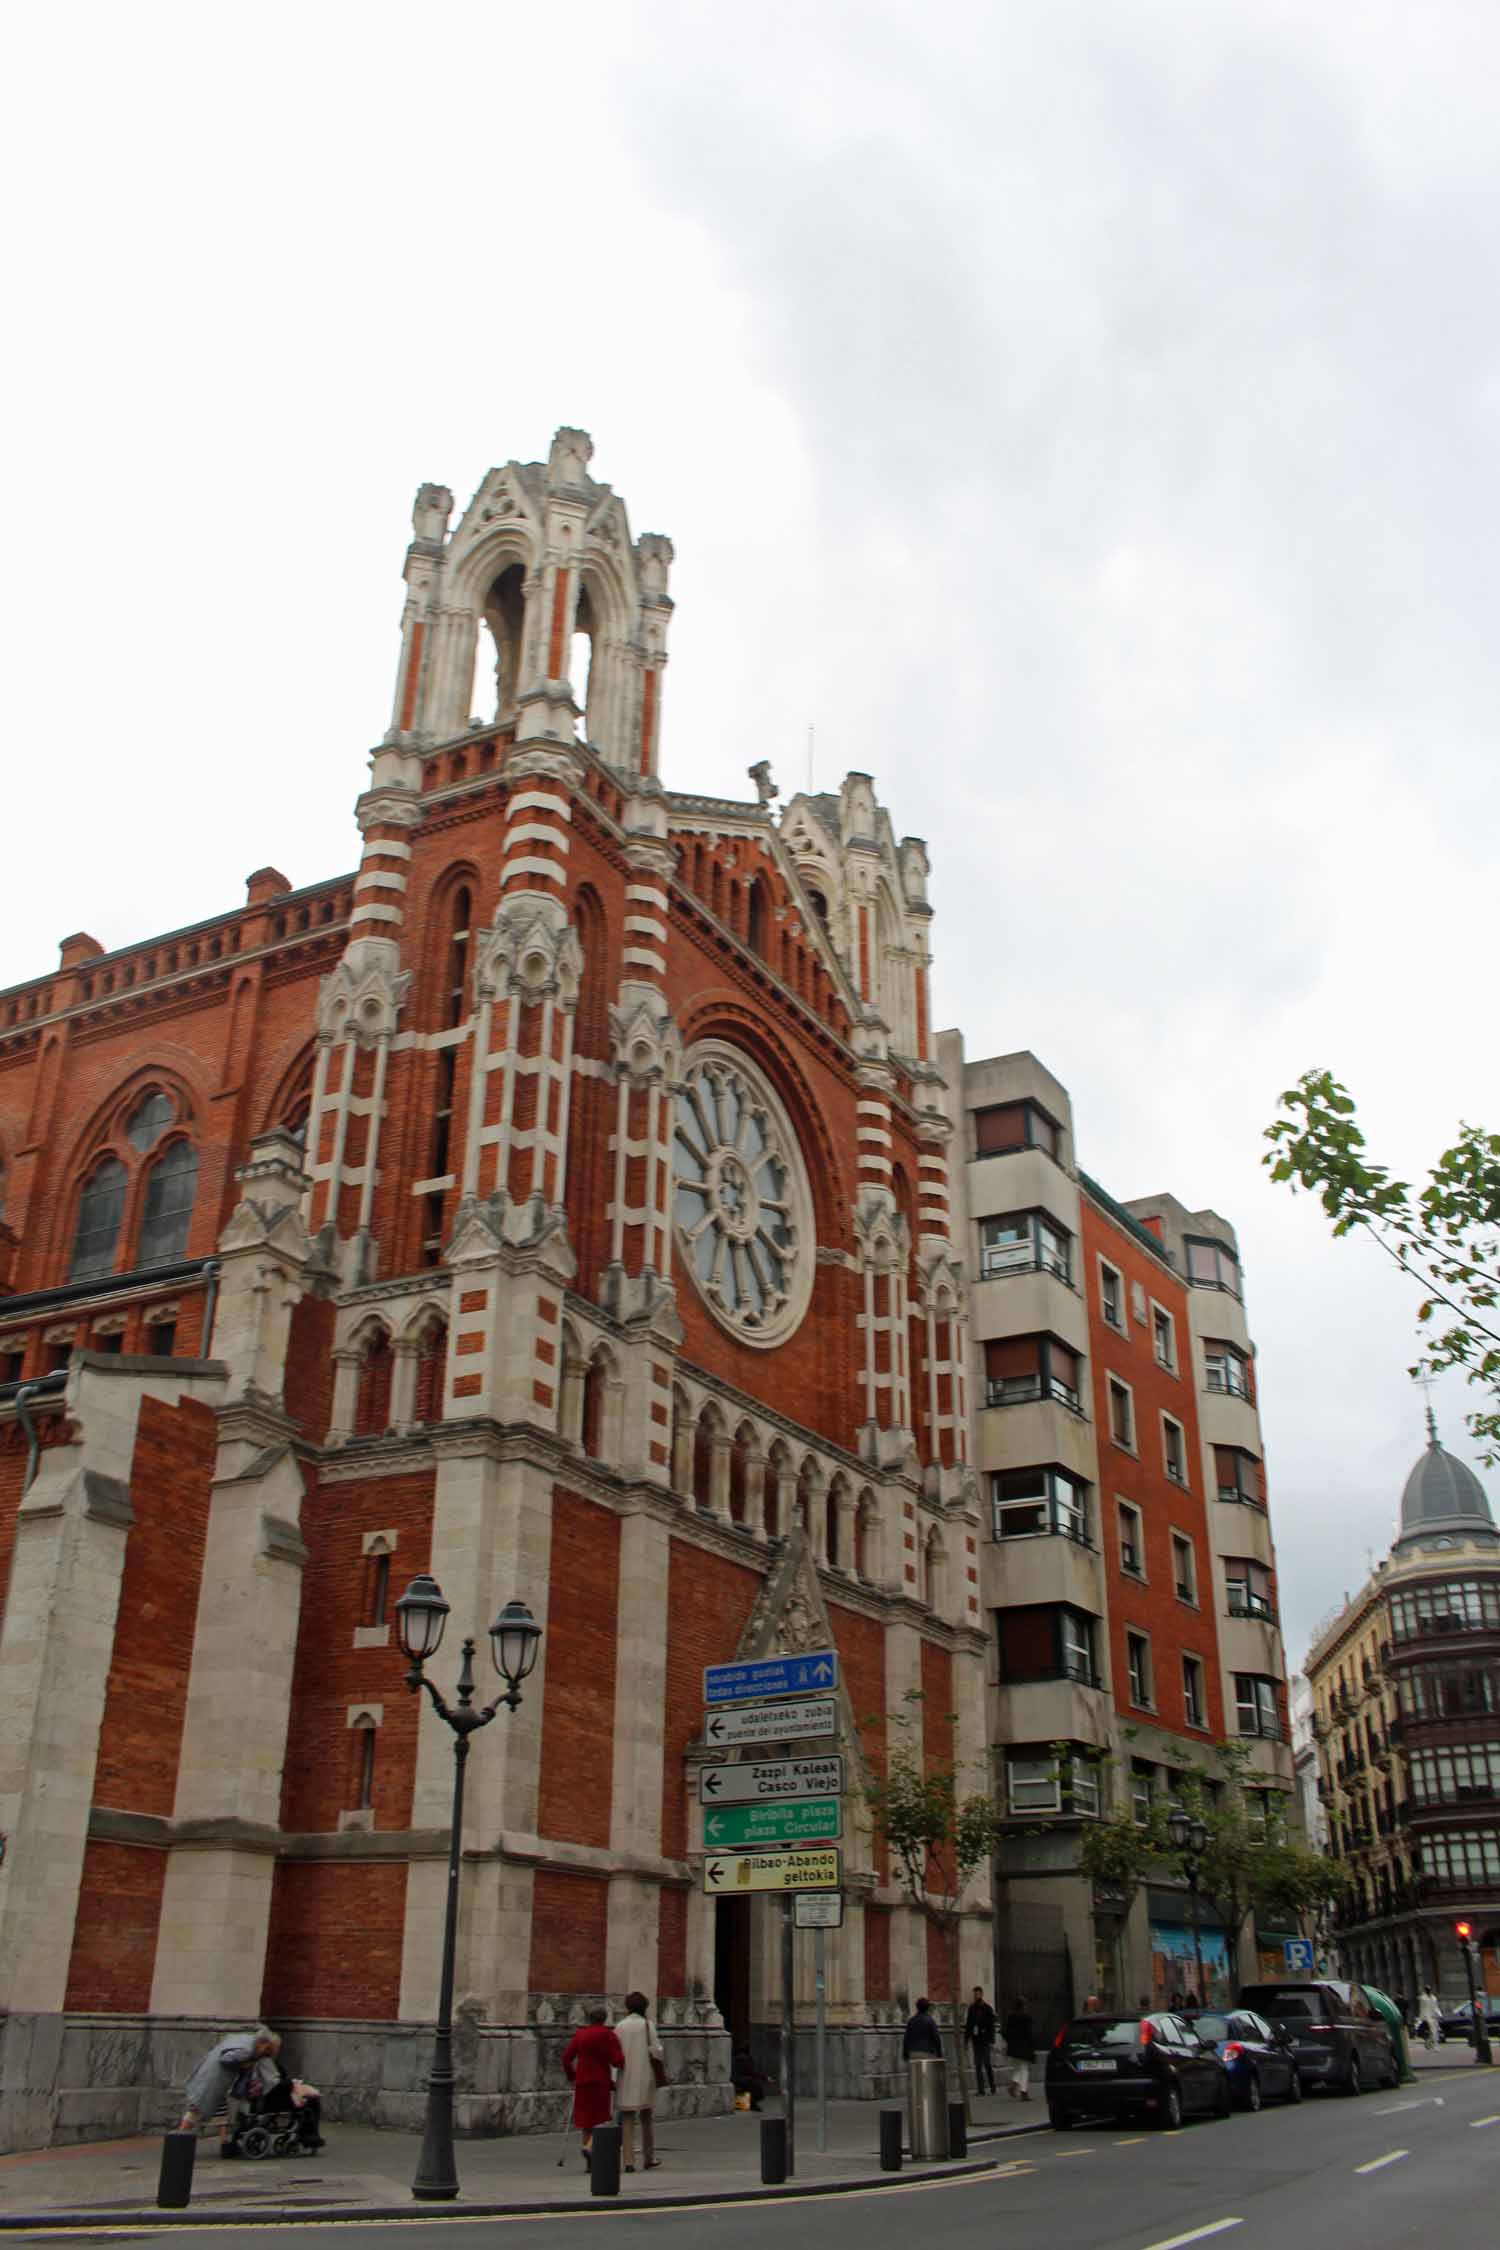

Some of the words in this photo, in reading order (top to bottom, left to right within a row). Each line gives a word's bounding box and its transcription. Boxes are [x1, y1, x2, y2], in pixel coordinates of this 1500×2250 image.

[735, 1680, 789, 1694] direcciones
[741, 1709, 798, 1724] udaletxeko
[804, 1705, 833, 1718] zubia
[728, 1728, 755, 1740] puente
[759, 1726, 769, 1736] del
[773, 1720, 833, 1737] ayuntamiento
[752, 1767, 786, 1780] Zazpi
[793, 1761, 837, 1776] Kaleak
[758, 1781, 798, 1793] Casco
[806, 1777, 839, 1790] Viejo
[801, 1805, 834, 1820] plaza
[743, 1824, 777, 1839] plaza
[784, 1820, 836, 1834] Circular
[784, 1869, 835, 1885] geltokia
[1289, 1943, 1308, 1968] P
